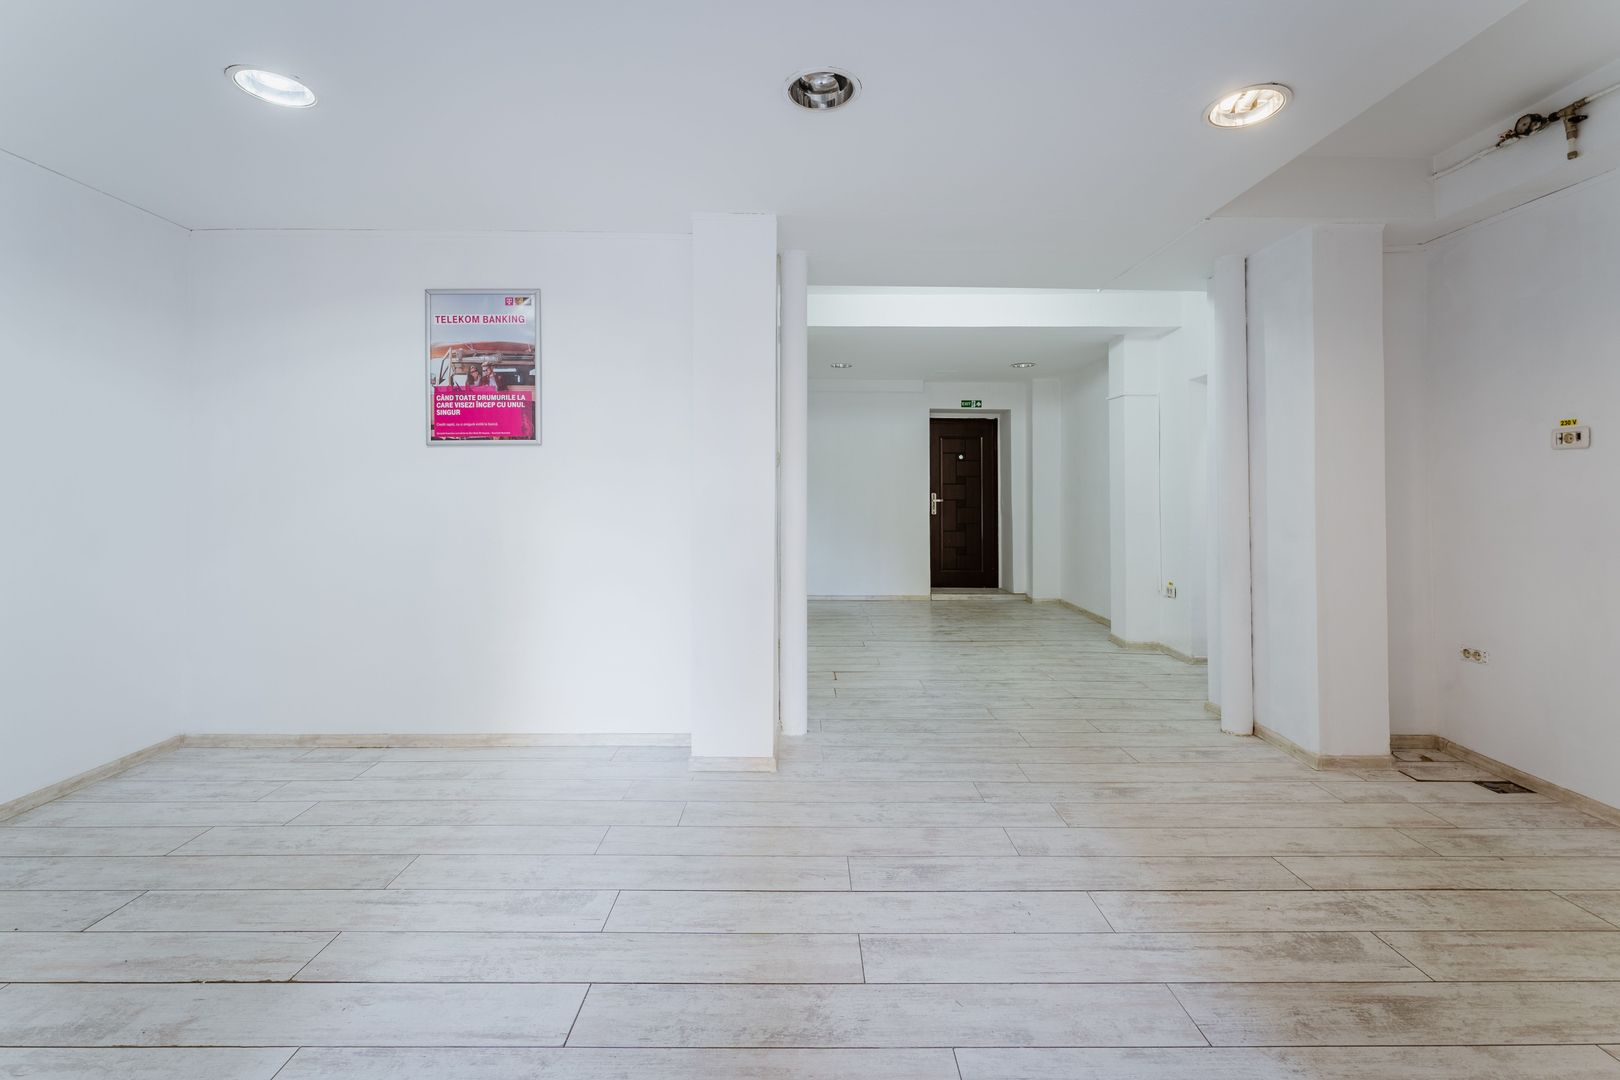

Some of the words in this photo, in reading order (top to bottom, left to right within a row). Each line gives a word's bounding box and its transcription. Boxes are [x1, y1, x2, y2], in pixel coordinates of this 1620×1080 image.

[435, 315, 480, 324] TELEKOM
[482, 315, 525, 324] BANKING
[436, 393, 454, 401] CÂND
[475, 400, 496, 408] ÎNCEP
